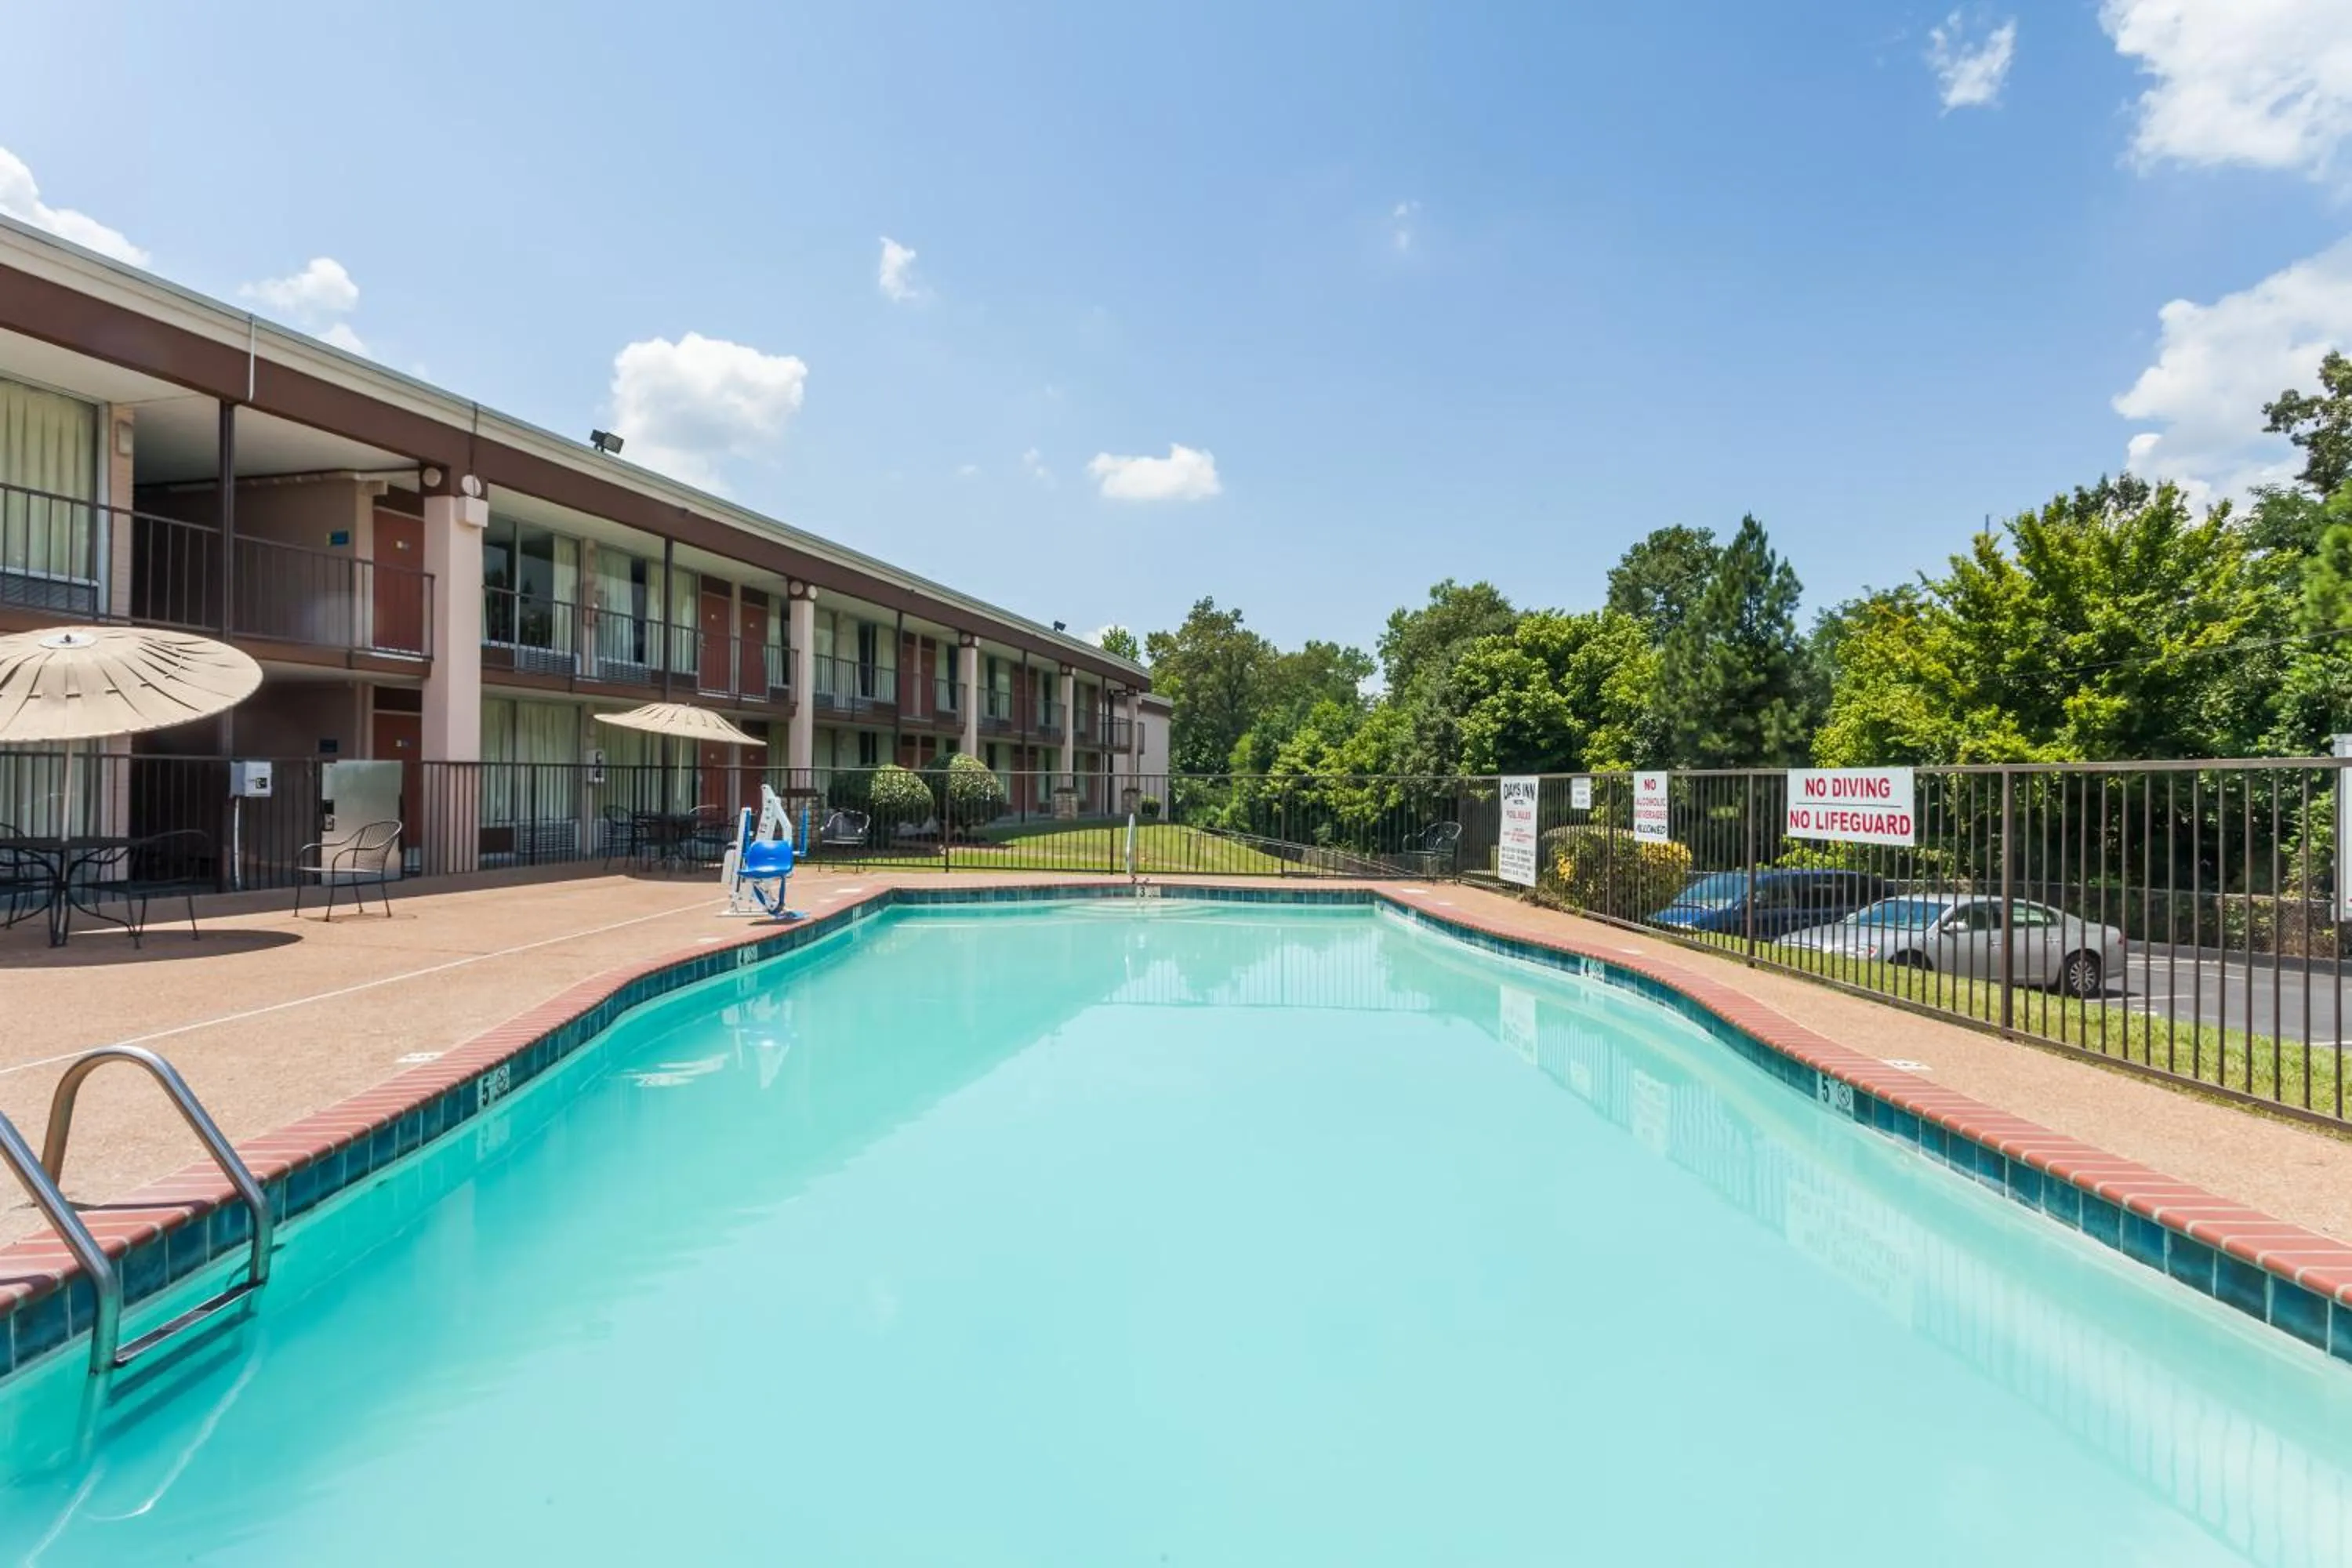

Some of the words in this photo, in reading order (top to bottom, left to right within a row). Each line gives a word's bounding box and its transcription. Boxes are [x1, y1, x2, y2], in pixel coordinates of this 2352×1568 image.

[1504, 782, 1522, 800] DAYS
[1523, 783, 1536, 800] INN
[1644, 779, 1657, 790] NO
[1806, 778, 1827, 797] NO
[1832, 778, 1891, 798] DIVING
[1636, 824, 1666, 834] ALLOWED
[1789, 810, 1810, 829] NO
[1816, 811, 1911, 836] LIFEGUARD
[1140, 887, 1145, 898] 3
[482, 1077, 490, 1105] 5
[1822, 1074, 1830, 1103] 5
